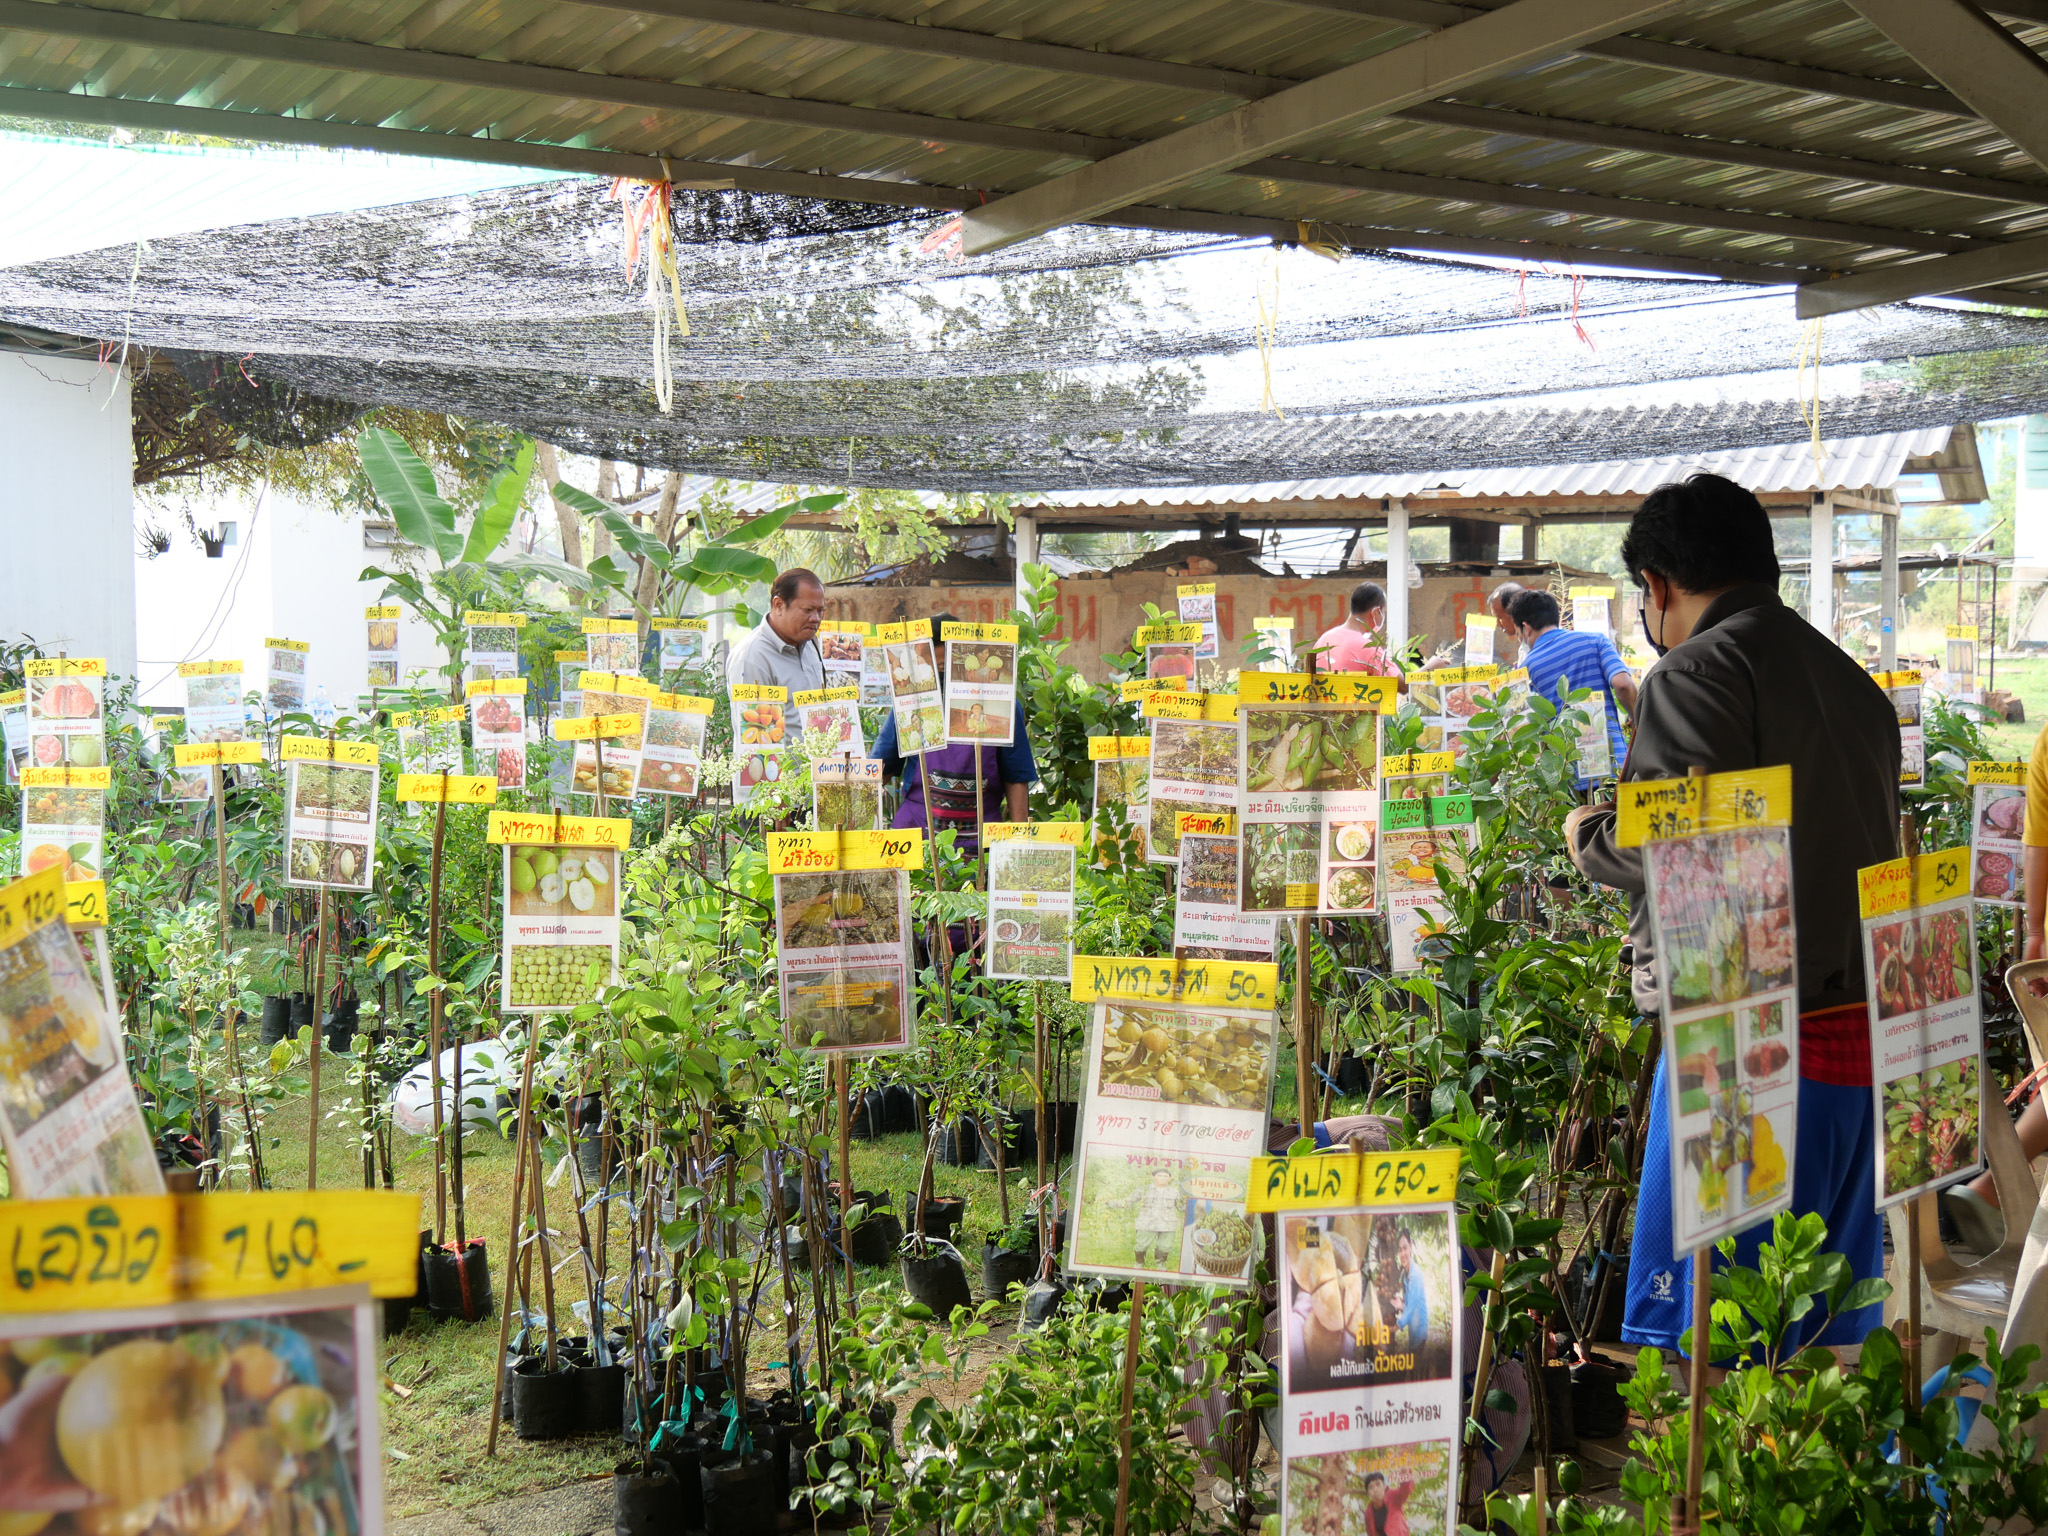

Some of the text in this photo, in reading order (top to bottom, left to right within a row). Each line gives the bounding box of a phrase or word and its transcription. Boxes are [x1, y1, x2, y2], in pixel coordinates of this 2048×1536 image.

[914, 623, 927, 637] 80
[1354, 681, 1384, 704] 70
[1446, 801, 1467, 819] 80
[1934, 860, 1959, 894] 50
[1093, 965, 1152, 998] พุทรา
[1096, 1114, 1132, 1136] พุทรา
[1137, 1117, 1148, 1130] 3
[1266, 1157, 1342, 1200] คีเปล
[1355, 1321, 1391, 1348] คีเปล
[1299, 1400, 1443, 1436] คีเปล กินแล้วตัวหอม
